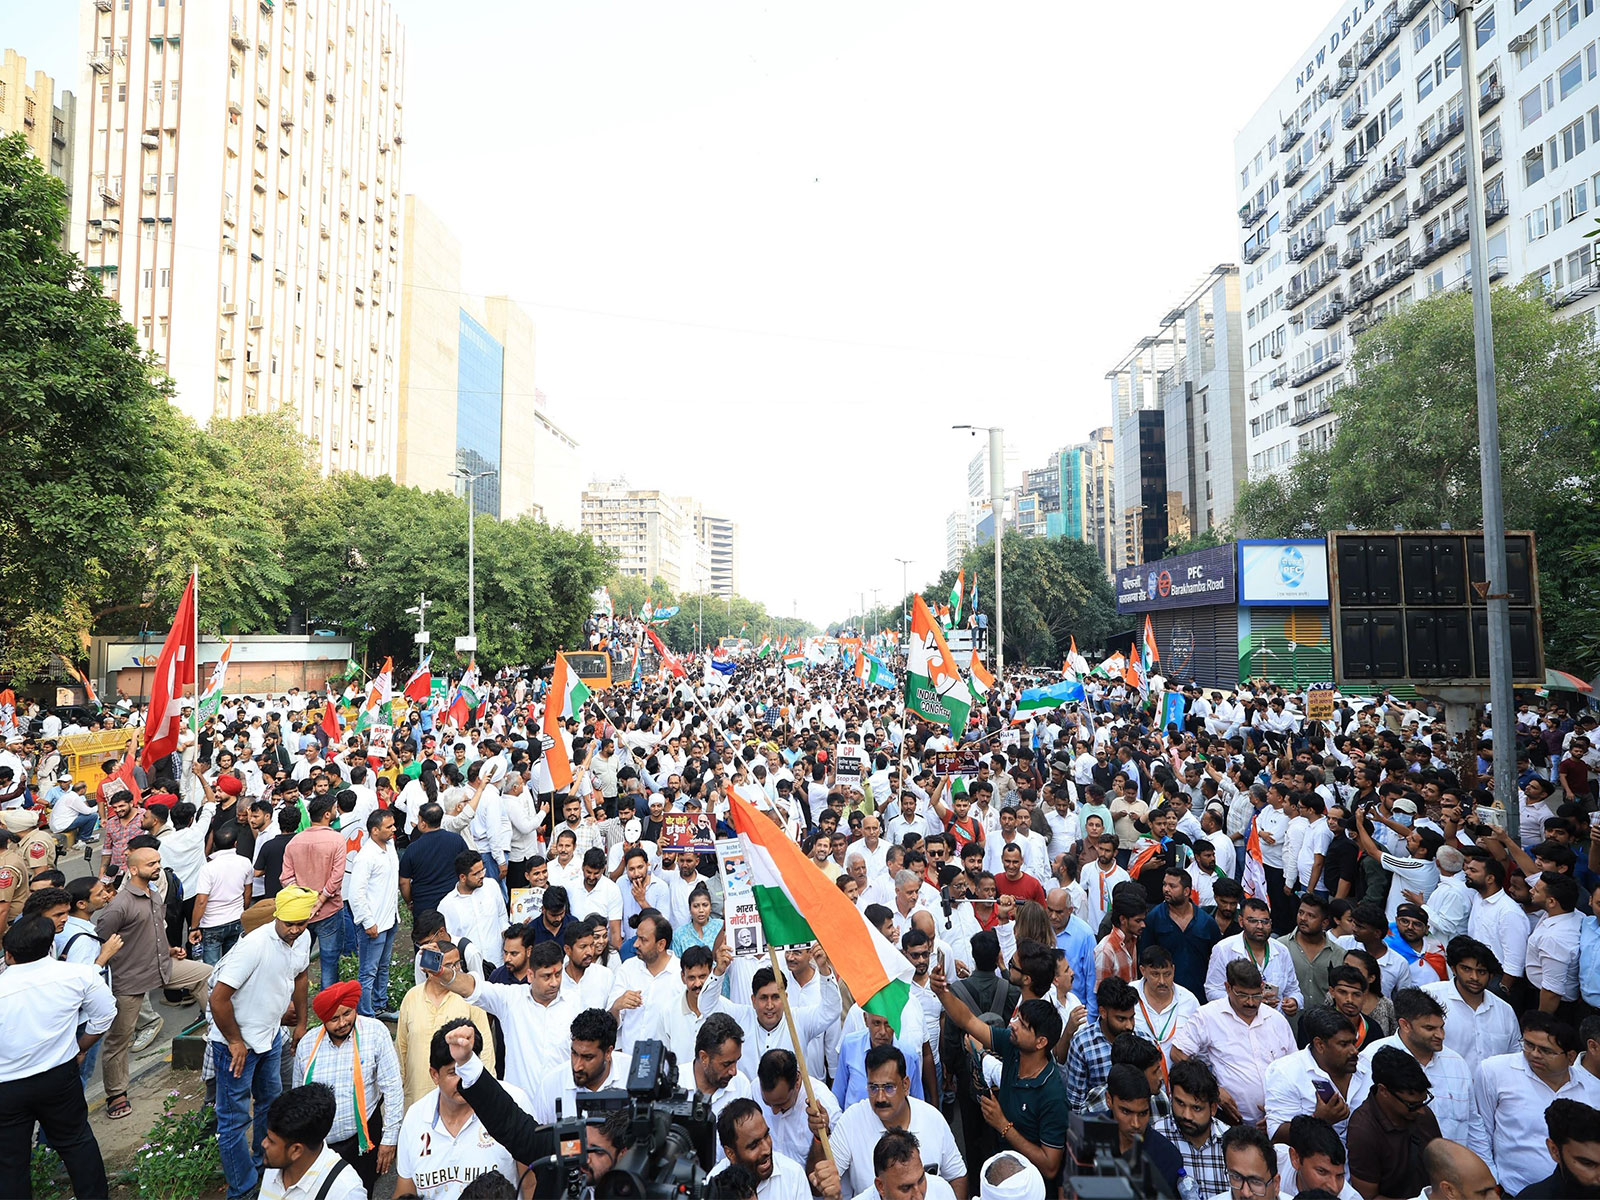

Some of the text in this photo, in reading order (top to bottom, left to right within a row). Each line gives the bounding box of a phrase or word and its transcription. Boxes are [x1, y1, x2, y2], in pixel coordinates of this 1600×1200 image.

[1296, 45, 1326, 93] NEW
[1187, 565, 1203, 579] PFC
[1171, 577, 1224, 596] Barakhamba Road
[843, 747, 855, 756] CPI
[665, 815, 688, 825] वोट चोरी
[673, 833, 679, 846] ?
[736, 904, 753, 913] भारत
[420, 1132, 431, 1157] 2
[416, 1166, 459, 1187] BEVERLY
